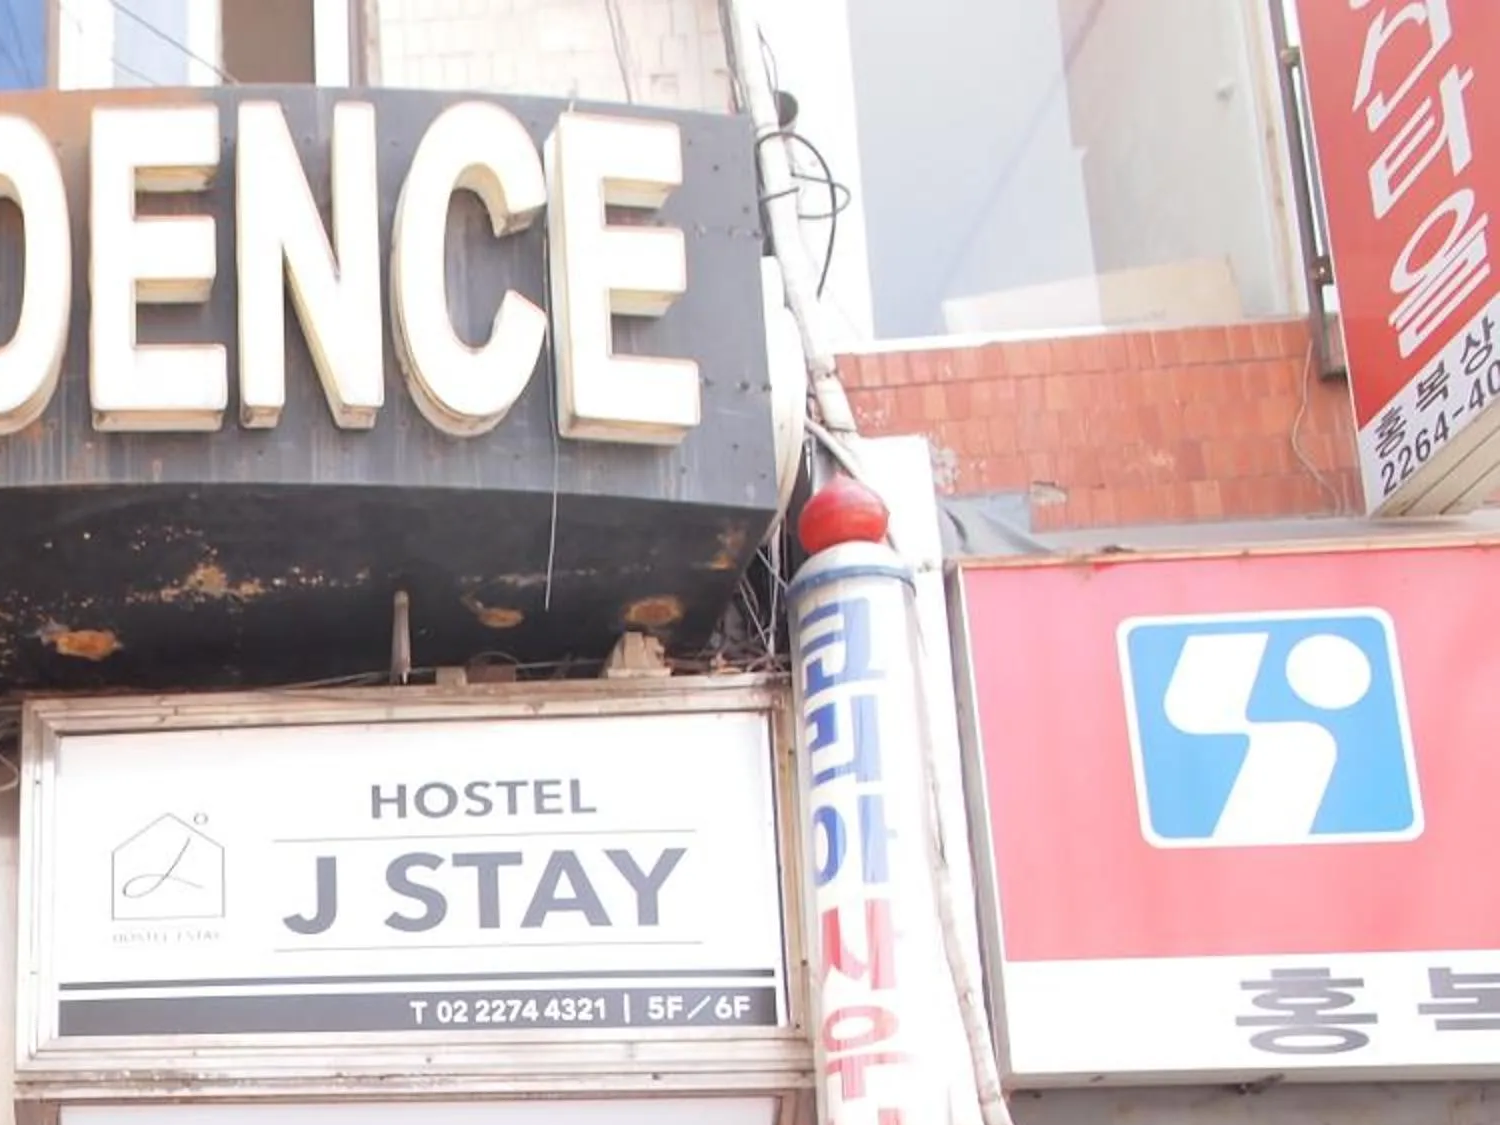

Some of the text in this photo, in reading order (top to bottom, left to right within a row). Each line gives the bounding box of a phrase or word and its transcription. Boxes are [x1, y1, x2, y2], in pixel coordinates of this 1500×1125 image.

[370, 778, 598, 819] HOSTEL
[282, 847, 688, 934] J STAY
[410, 1001, 427, 1024] T
[436, 1001, 468, 1023] 02
[475, 999, 538, 1022] 2274
[544, 998, 605, 1021] 4321
